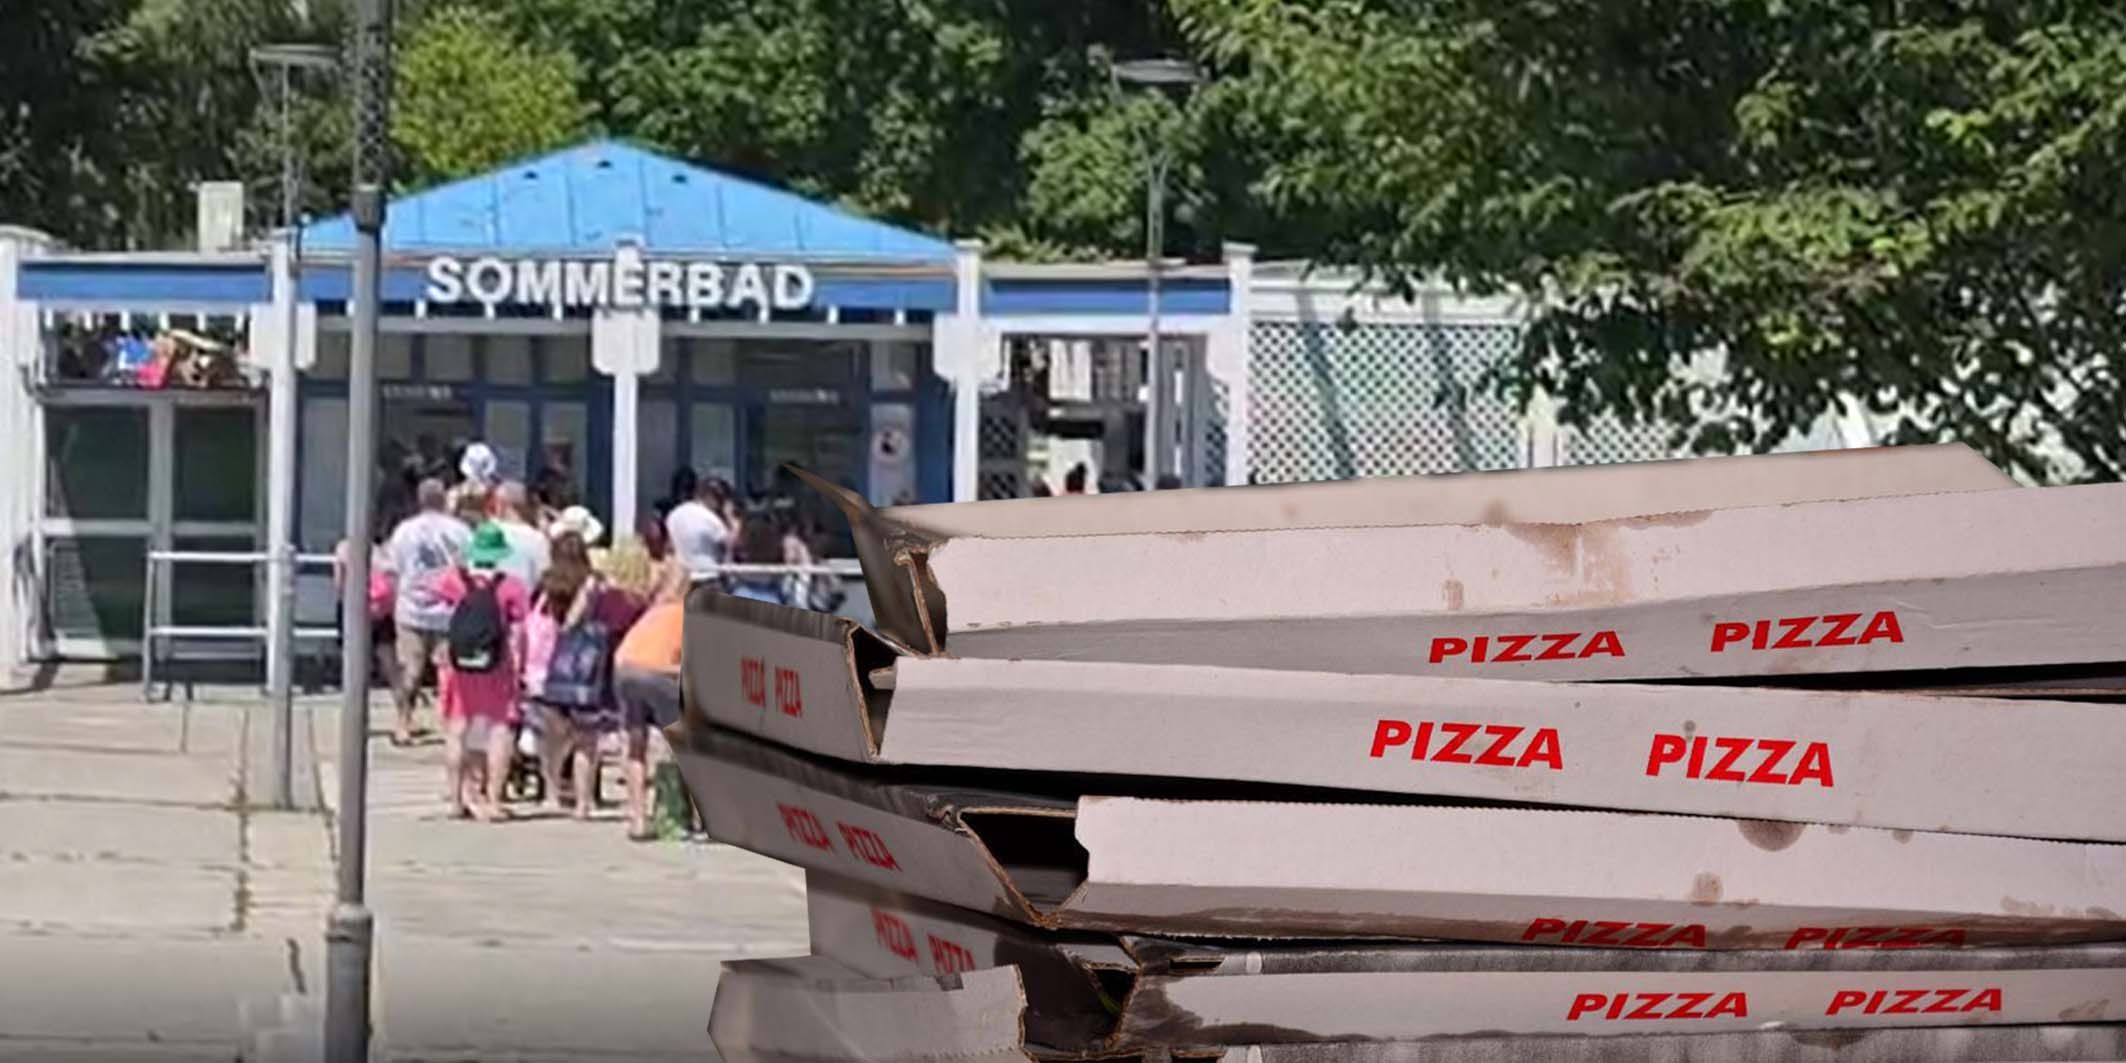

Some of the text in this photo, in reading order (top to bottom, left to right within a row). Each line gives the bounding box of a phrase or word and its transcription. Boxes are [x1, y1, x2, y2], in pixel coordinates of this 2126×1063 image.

[427, 256, 815, 311] SOMMERBAD
[1429, 610, 1904, 664] PIZZA PIZZA
[741, 657, 803, 718] PIZZA PIZZA
[1370, 719, 1834, 787] PIZZA PIZZA
[778, 804, 902, 872] PIZZA PIZZA
[873, 907, 920, 966] PIZZA
[1522, 917, 1966, 951] PIZZA PIZZA
[1567, 987, 2003, 1021] PIZZA PIZZA
